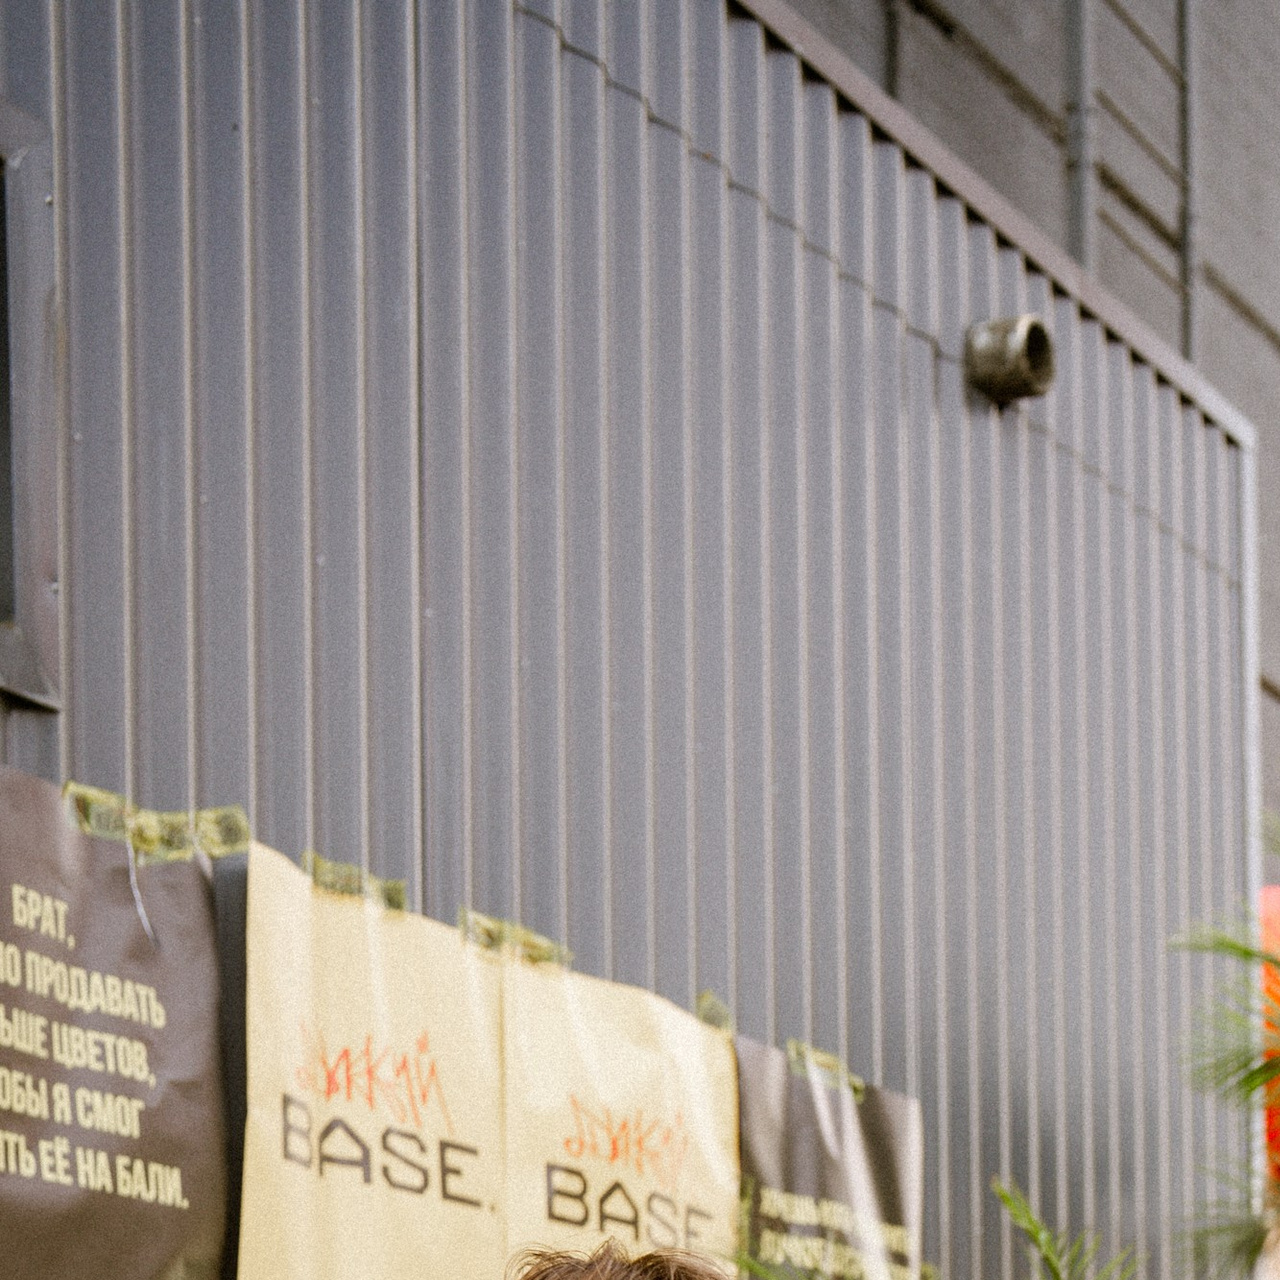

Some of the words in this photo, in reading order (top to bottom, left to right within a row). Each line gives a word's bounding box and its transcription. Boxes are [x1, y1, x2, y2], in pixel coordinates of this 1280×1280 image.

[12, 883, 76, 950] БРАТ,
[25, 951, 167, 1030] ПРОДАВАТЬ
[52, 1021, 156, 1091] ЦВЕТОВ,
[52, 1082, 73, 1126] Я
[75, 1087, 146, 1140] СМОГ
[38, 1136, 74, 1186] ЕЁ
[76, 1146, 115, 1195] НА
[116, 1155, 190, 1210] БАЛИ.
[282, 1093, 498, 1213] BASE.
